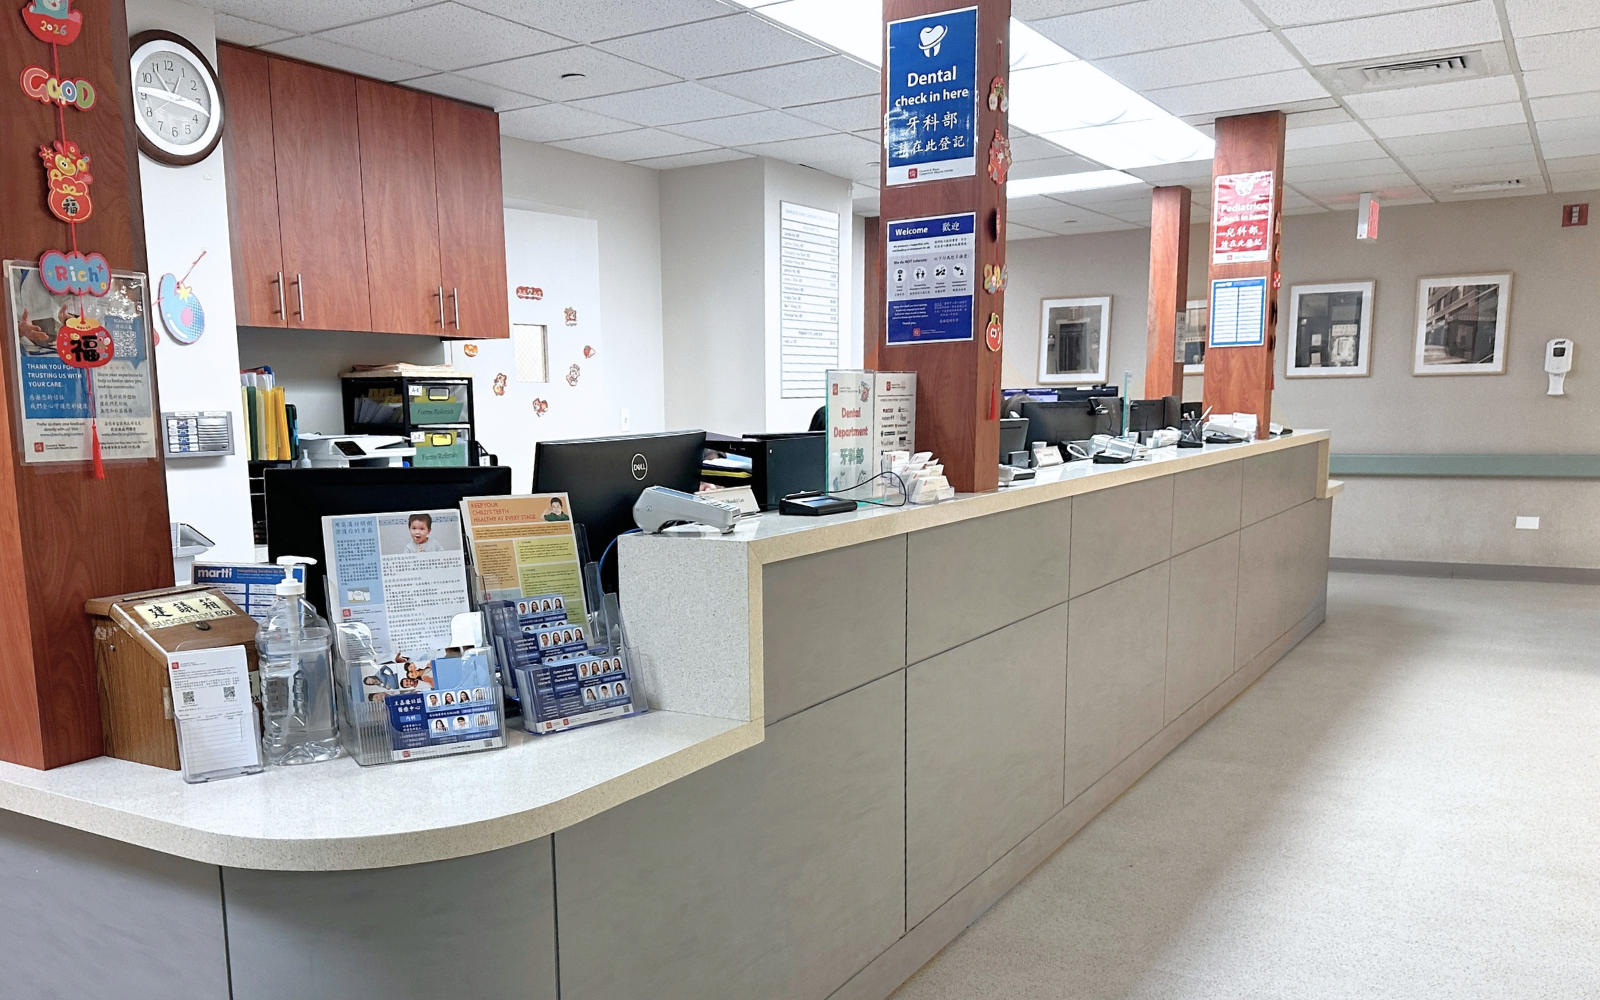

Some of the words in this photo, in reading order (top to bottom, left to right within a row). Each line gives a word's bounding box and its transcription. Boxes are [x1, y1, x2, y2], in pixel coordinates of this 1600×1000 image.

[40, 20, 67, 36] 2026
[151, 63, 160, 73] 11
[163, 60, 174, 72] 12
[142, 72, 152, 84] 10
[181, 67, 185, 78] 1
[907, 66, 957, 88] Dental
[23, 67, 95, 109] GOOD
[190, 80, 197, 91] 2
[895, 92, 927, 107] check
[929, 91, 940, 103] in
[943, 88, 969, 100] here
[146, 107, 153, 117] 8
[192, 114, 198, 124] 4
[906, 111, 958, 134] 牙科部
[158, 121, 164, 131] 7
[172, 127, 179, 137] 6
[185, 124, 191, 135] 5
[898, 135, 965, 158] 請在此登記
[63, 198, 78, 214] 福
[1220, 202, 1267, 213] Pediatrics
[895, 226, 929, 237] Welcome
[942, 221, 960, 232] 歡迎
[1226, 225, 1259, 237] 兒科部
[55, 265, 99, 282] Rich
[70, 335, 100, 362] 福
[842, 407, 861, 419] Dental
[833, 426, 868, 439] Department
[840, 447, 864, 465] 牙科部
[633, 462, 646, 471] DELL
[198, 567, 232, 578] martti
[148, 597, 221, 619] 建議箱
[152, 612, 213, 628] SUGGESTION
[214, 609, 235, 617] BOX
